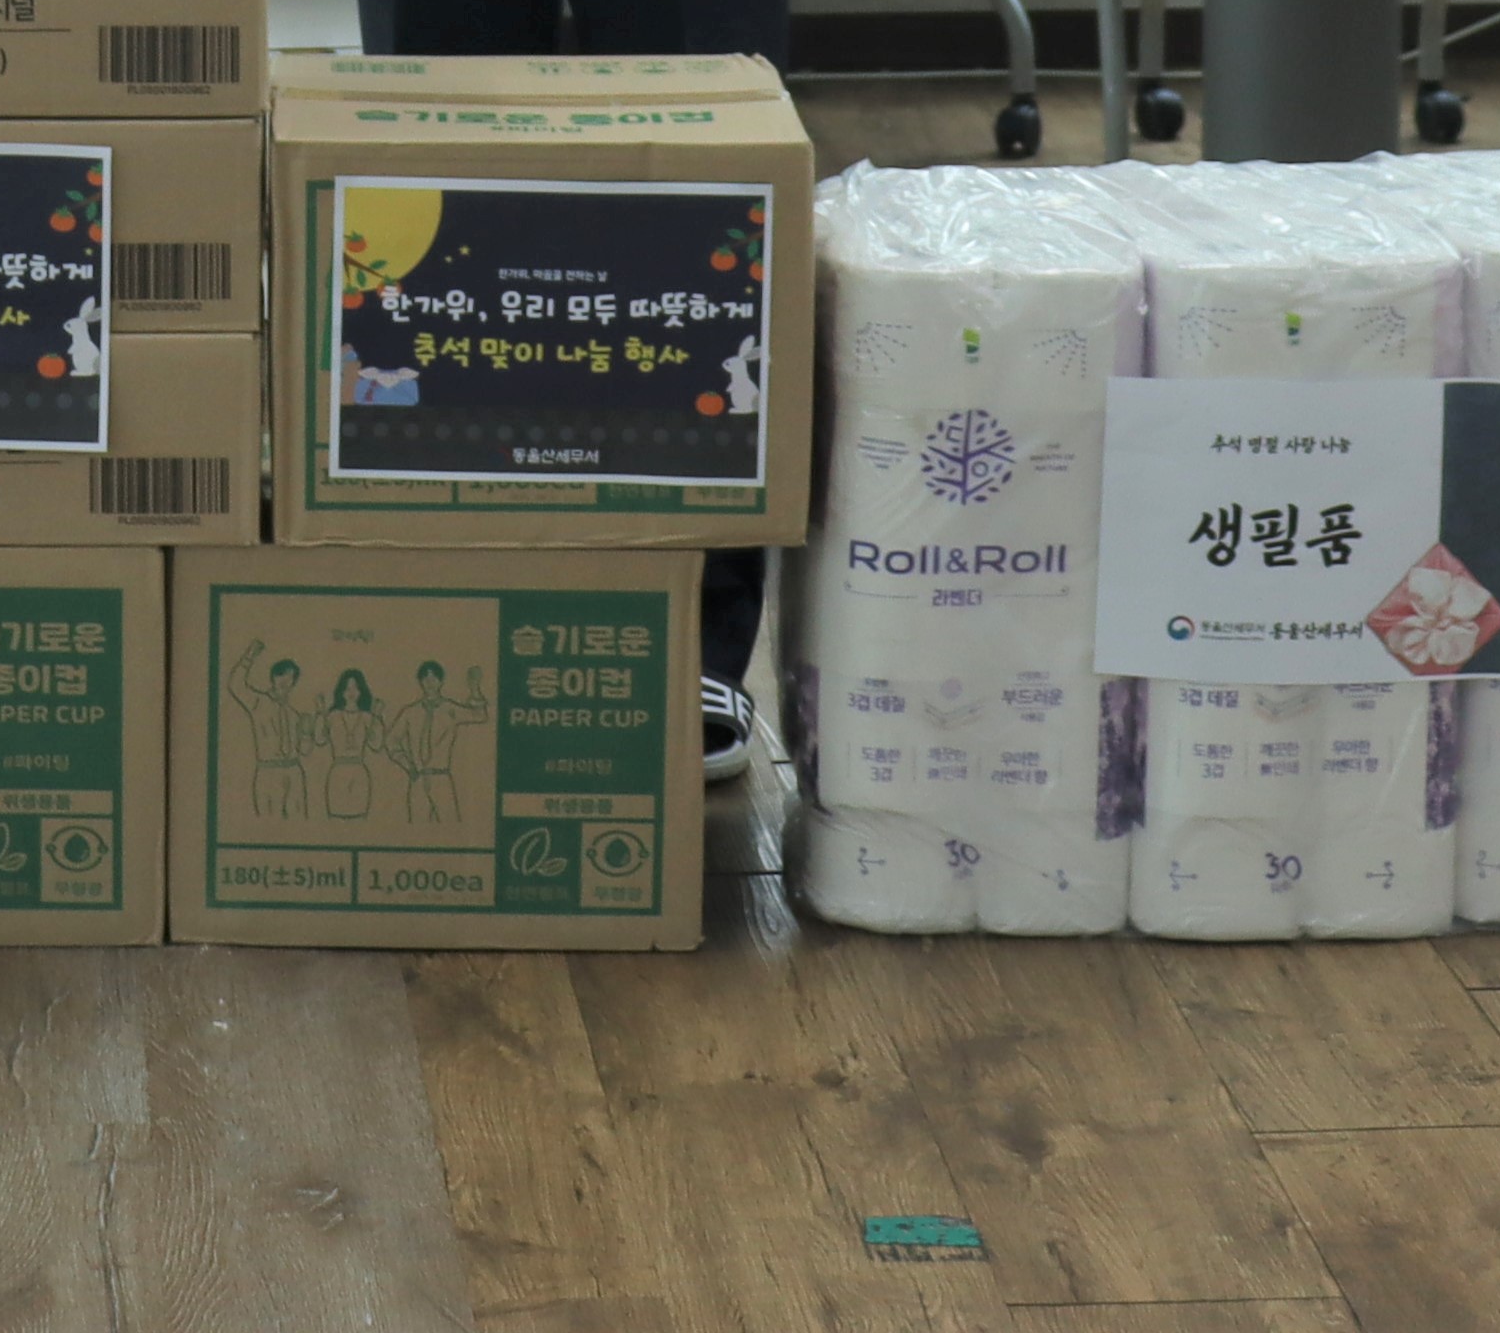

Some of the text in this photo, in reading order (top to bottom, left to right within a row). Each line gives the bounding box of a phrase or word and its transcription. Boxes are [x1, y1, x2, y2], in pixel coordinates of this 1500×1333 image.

[381, 285, 754, 328] 한가위, 우리 모두 따뜻하게
[414, 333, 690, 374] 추석 맞이 나눔 행사
[511, 445, 600, 466] 동울산세무서
[1210, 434, 1352, 454] 추석 명절 사랑 나눔
[1188, 502, 1363, 568] 생필품
[848, 539, 1068, 575] Roll&Roll
[931, 588, 983, 607] 라벤더
[510, 624, 652, 658] 슬기로운
[1269, 622, 1365, 640] 동울산세무서
[526, 666, 633, 700] 종이컵
[55, 704, 106, 725] CUP
[510, 708, 649, 728] PAPER CUP
[944, 839, 981, 867] 30
[1264, 852, 1302, 881] 30
[221, 865, 346, 889] 180(±5)ml
[367, 866, 484, 893] 1,000ea
